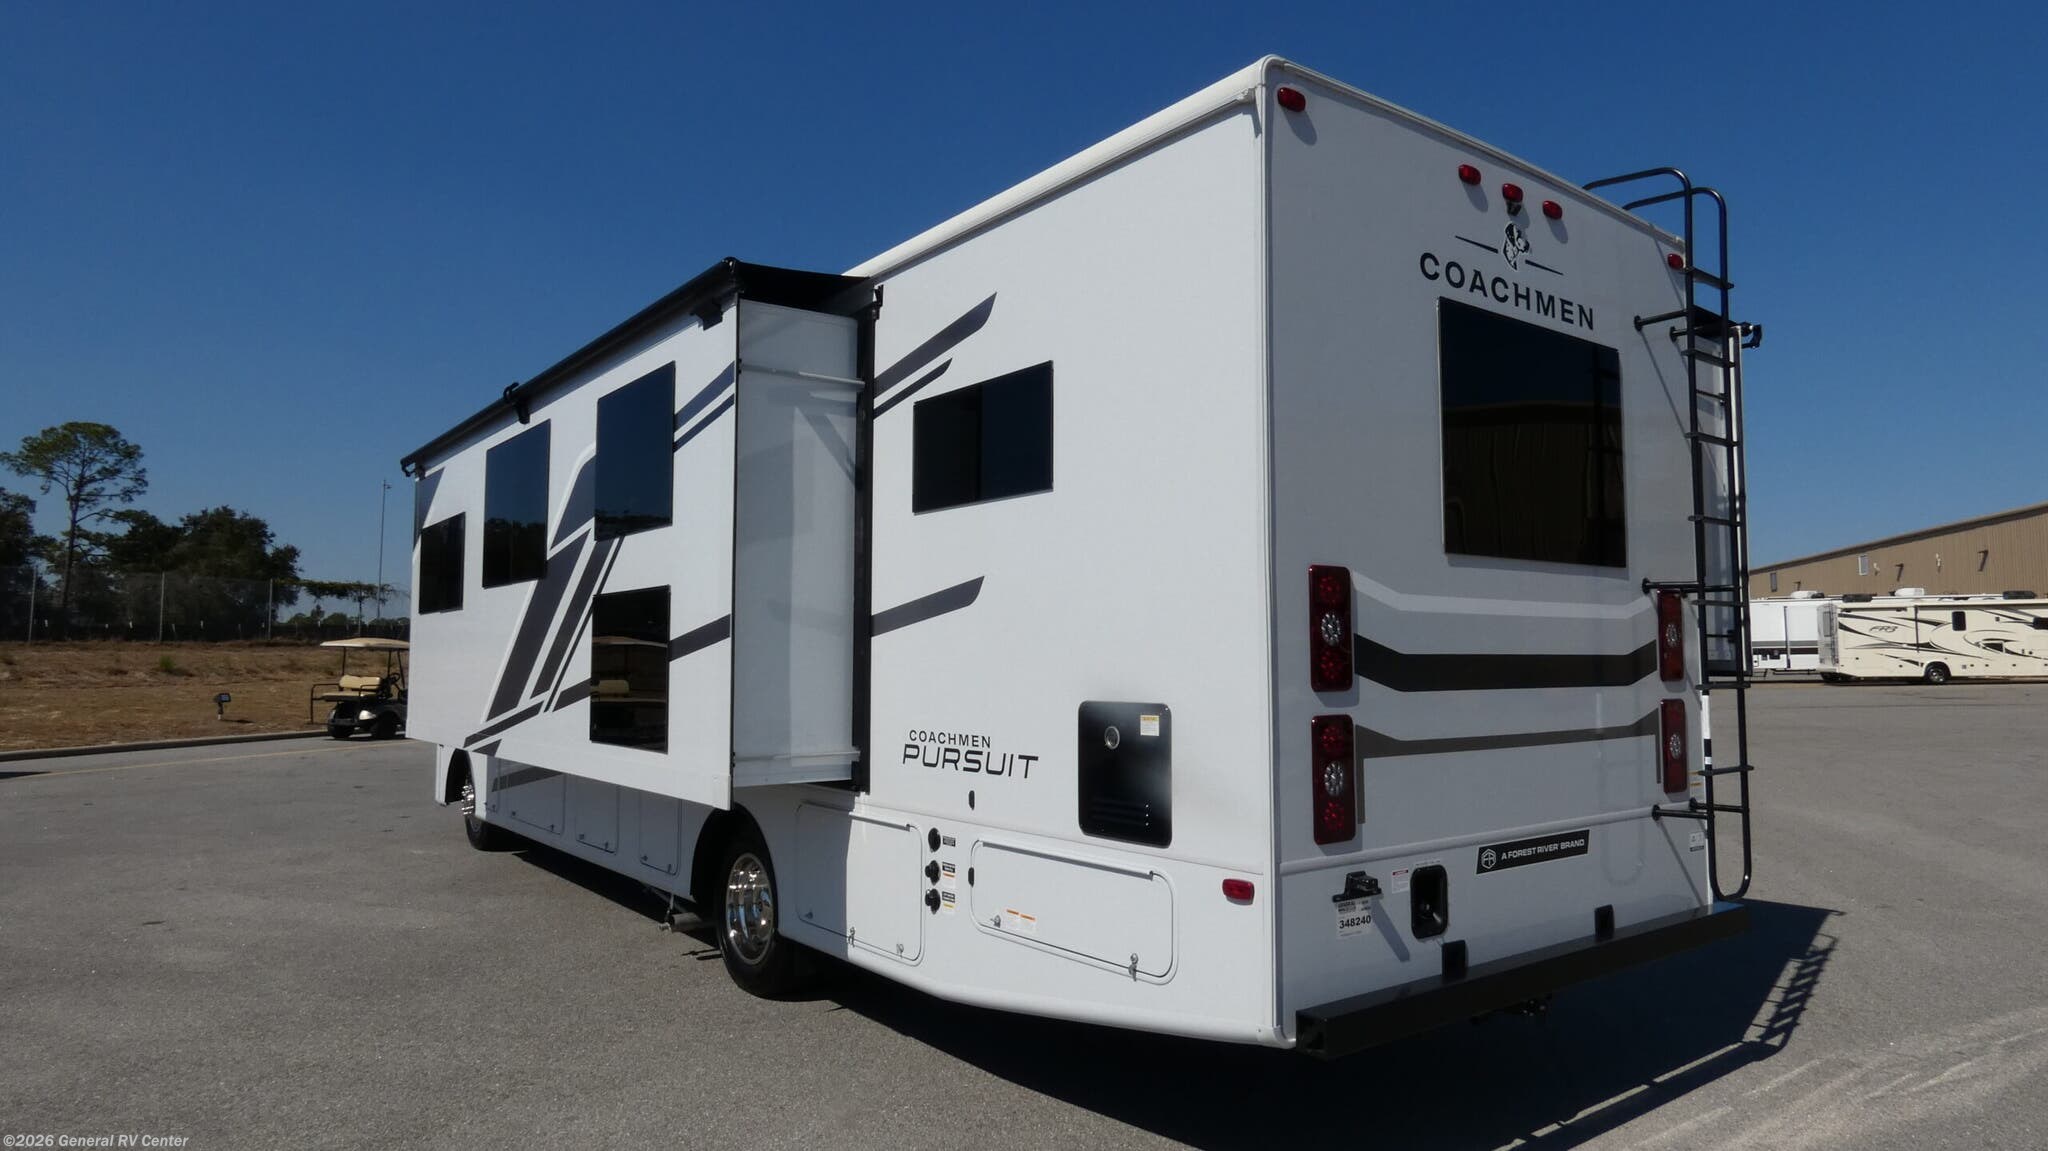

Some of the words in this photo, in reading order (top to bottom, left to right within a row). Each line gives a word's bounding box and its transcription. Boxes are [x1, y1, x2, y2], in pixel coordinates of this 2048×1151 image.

[1420, 252, 1594, 330] COACHMEN
[909, 729, 991, 749] COACHMEN
[902, 743, 1039, 779] PURSUIT
[1501, 852, 1508, 860] A
[1508, 847, 1537, 859] FOREST
[1537, 843, 1559, 853] RIVER
[1560, 838, 1585, 850] BRAND
[1339, 915, 1371, 929] 348240
